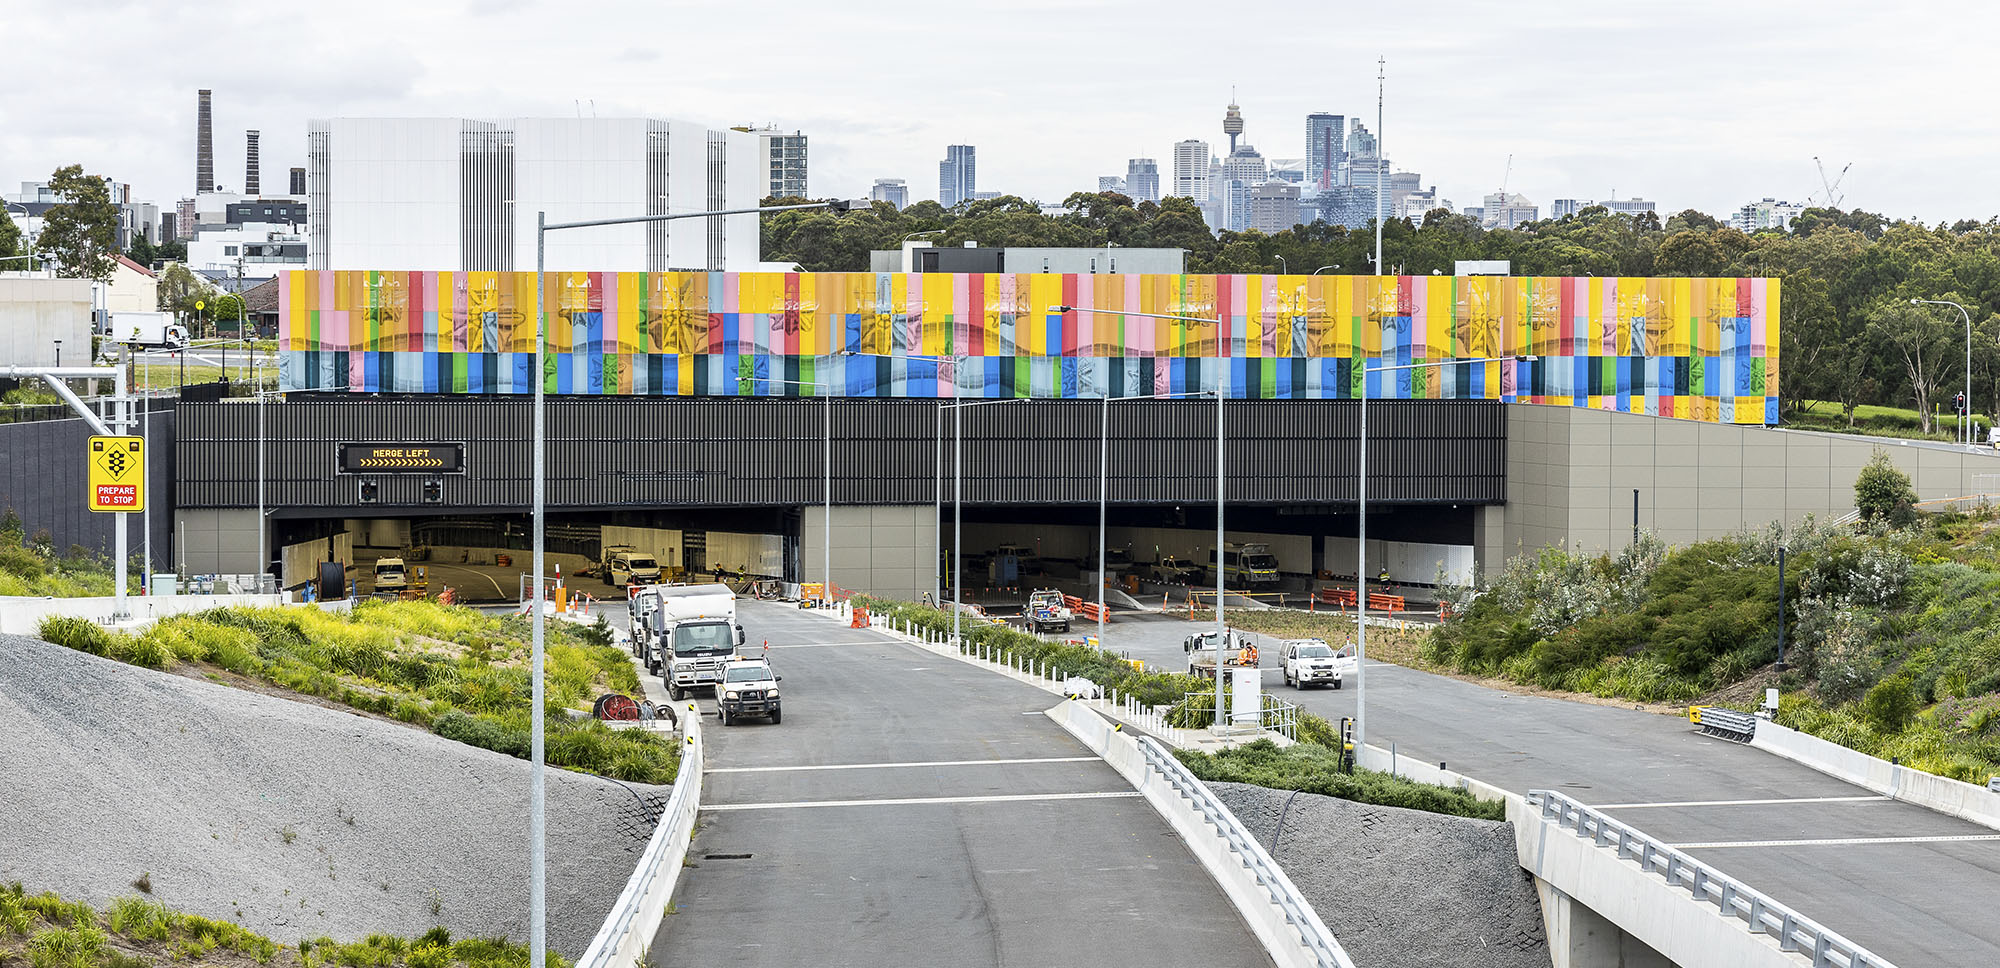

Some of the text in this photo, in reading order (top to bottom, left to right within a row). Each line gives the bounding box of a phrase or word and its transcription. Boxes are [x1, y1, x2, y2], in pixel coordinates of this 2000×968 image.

[373, 449, 430, 458] MERGE LEFT
[98, 486, 135, 495] PREPARE
[100, 496, 133, 504] TO STOP
